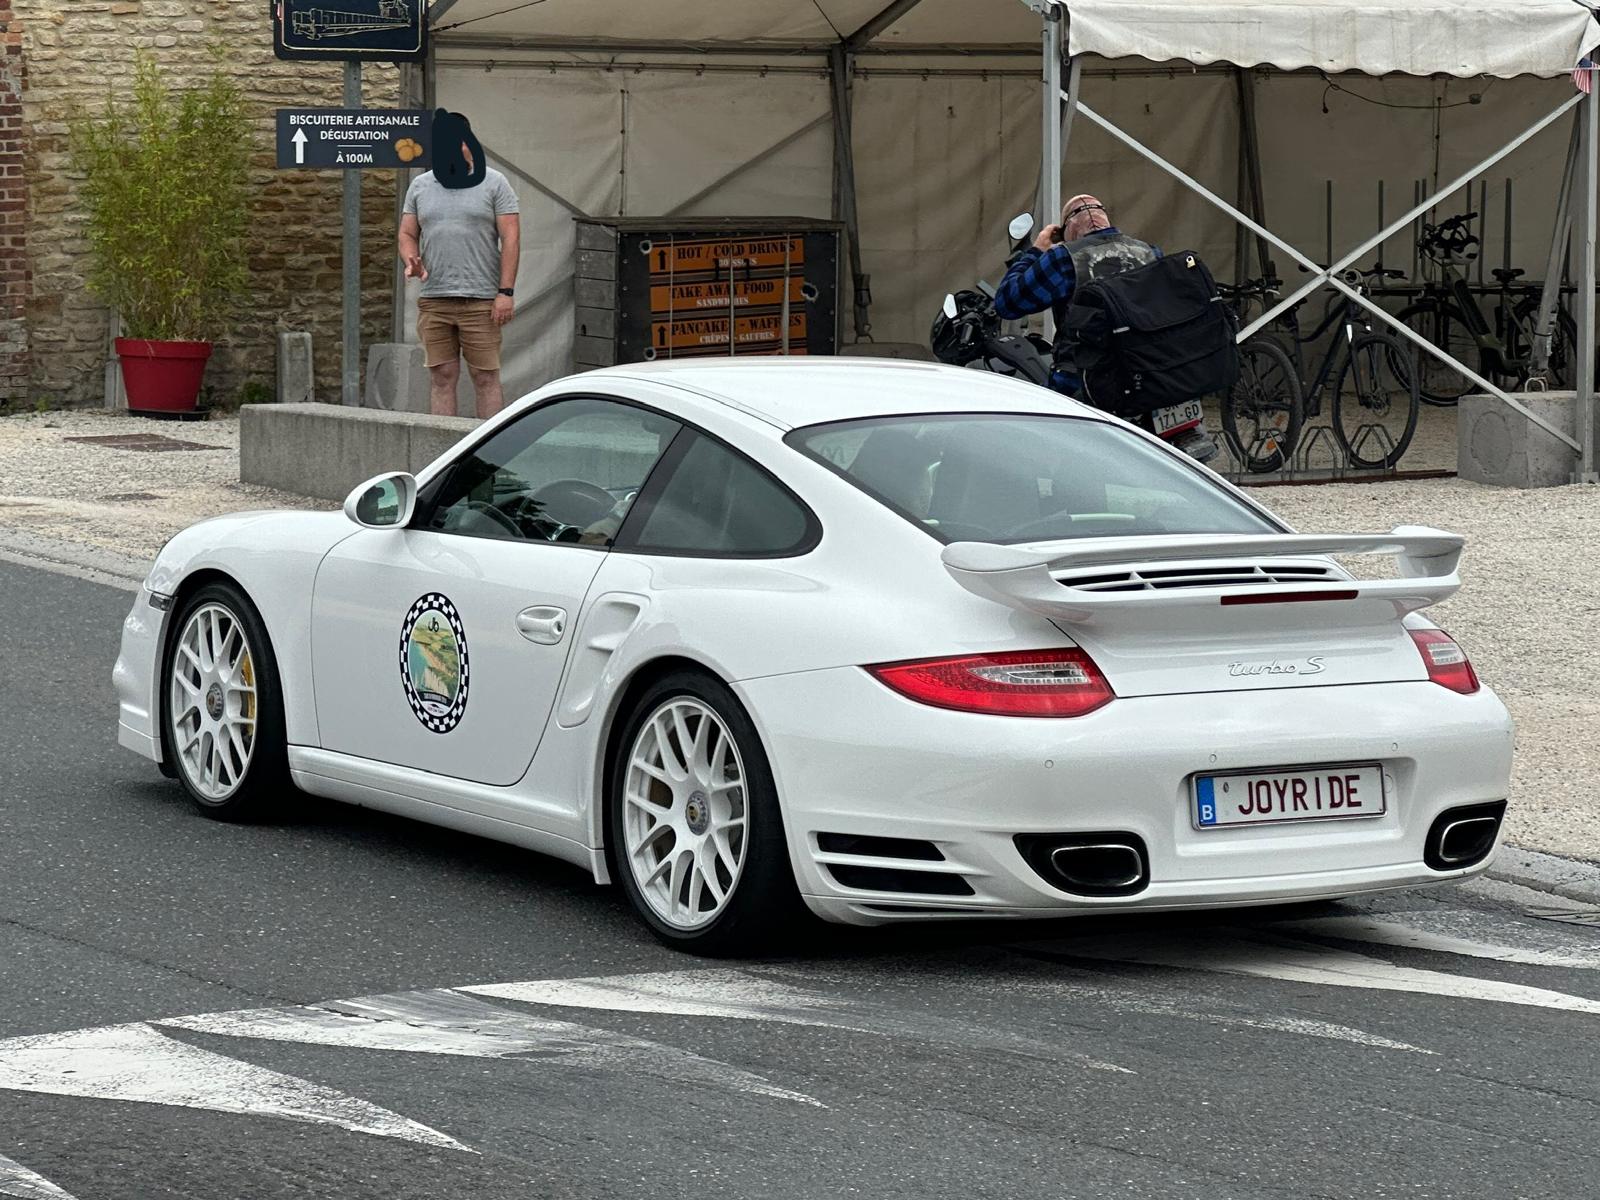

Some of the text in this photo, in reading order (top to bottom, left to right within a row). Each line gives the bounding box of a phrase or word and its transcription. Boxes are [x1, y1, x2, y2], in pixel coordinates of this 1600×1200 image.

[289, 114, 420, 126] BISCUITERIE ARTISANALE
[320, 128, 389, 141] DÉGUSTATION
[336, 150, 373, 163] À 100M
[677, 246, 703, 259] HOT
[713, 243, 745, 257] COLD
[750, 240, 796, 255] DRINKS
[669, 285, 702, 299] TAKE
[743, 281, 774, 295] FOOD
[671, 319, 736, 336] PANCAKE
[749, 315, 801, 329] WAFFES
[739, 331, 775, 342] GAUFRES
[1299, 655, 1327, 675] S
[1238, 774, 1363, 815] JOYRIDE
[1202, 804, 1214, 820] B
